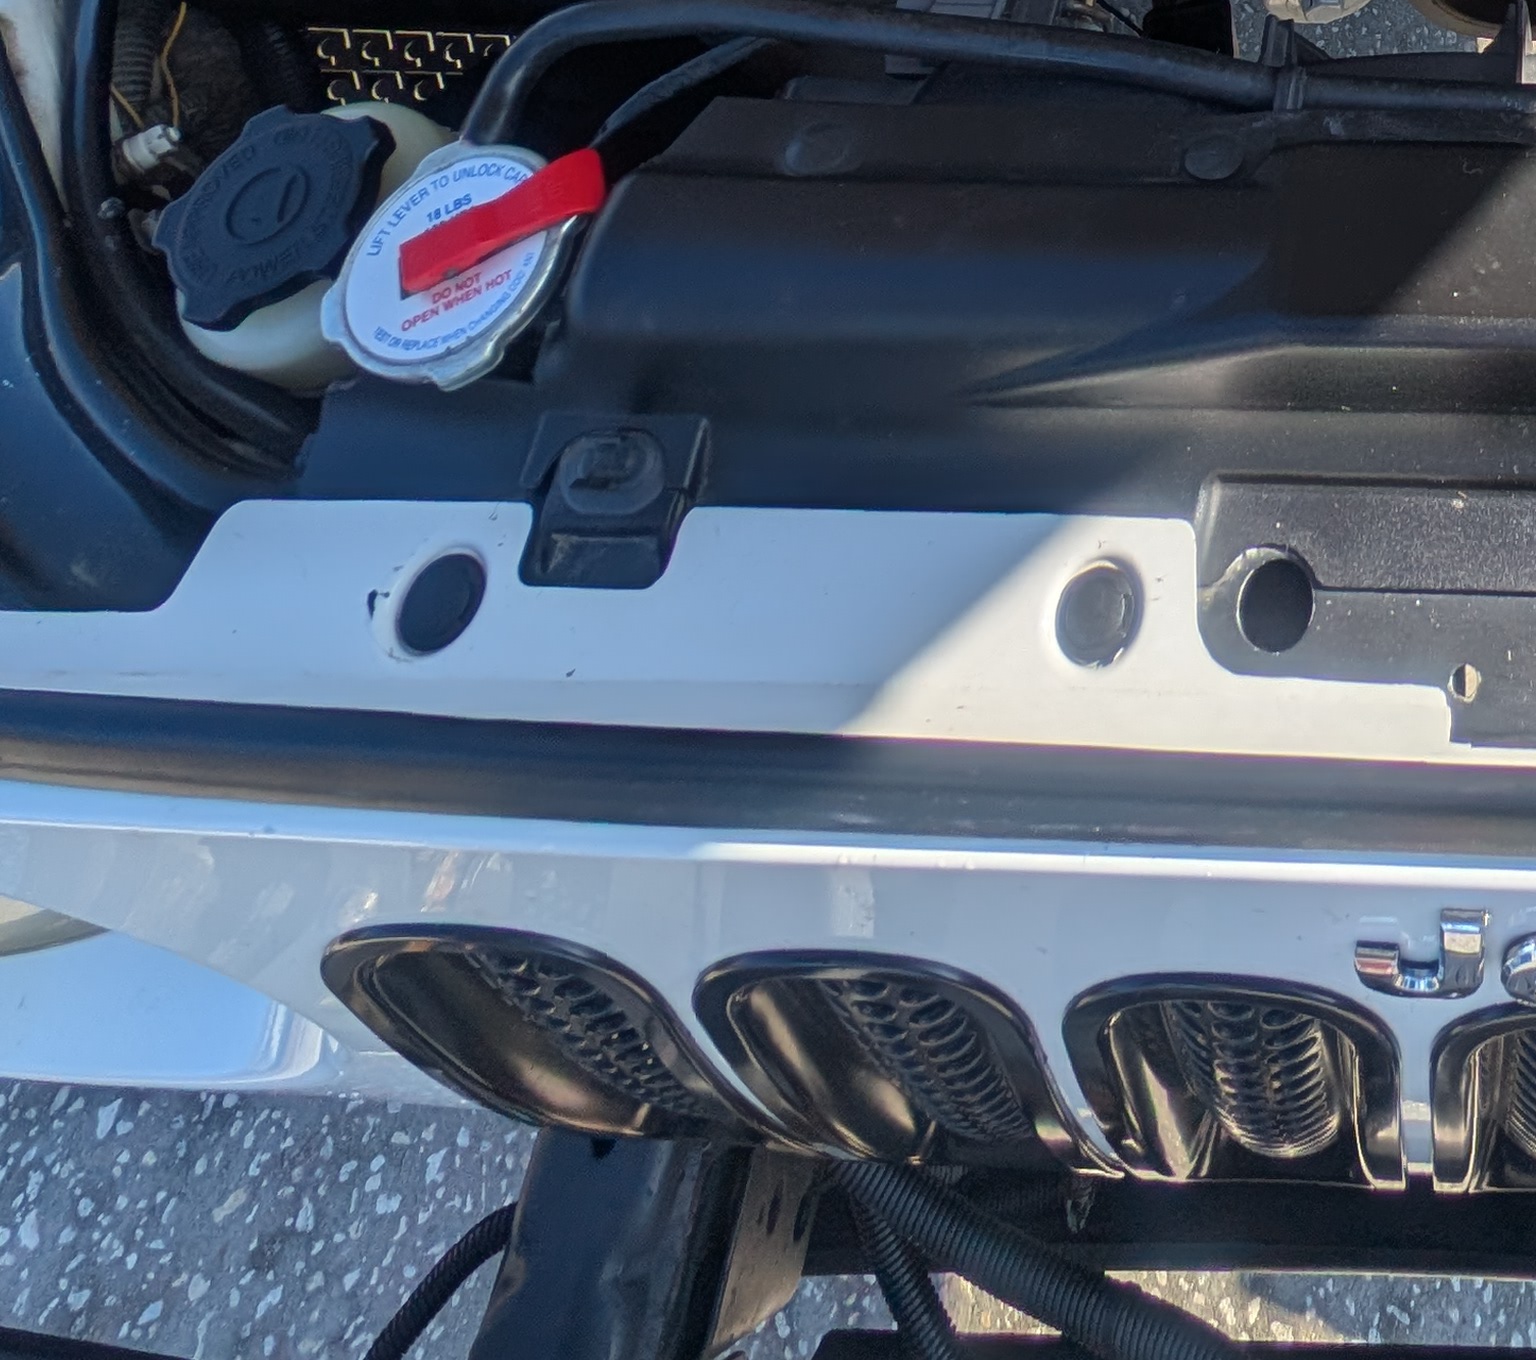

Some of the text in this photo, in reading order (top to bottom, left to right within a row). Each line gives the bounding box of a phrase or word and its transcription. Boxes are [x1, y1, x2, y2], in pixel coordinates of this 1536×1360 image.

[366, 227, 391, 258] LIFT
[387, 187, 431, 229] LEVER
[431, 175, 450, 192] TO
[453, 162, 504, 183] UNLOCK
[426, 208, 442, 223] 18
[445, 193, 473, 216] LBS
[401, 269, 513, 332] OPEN WHEN HOT
[432, 271, 482, 305] DO NOT
